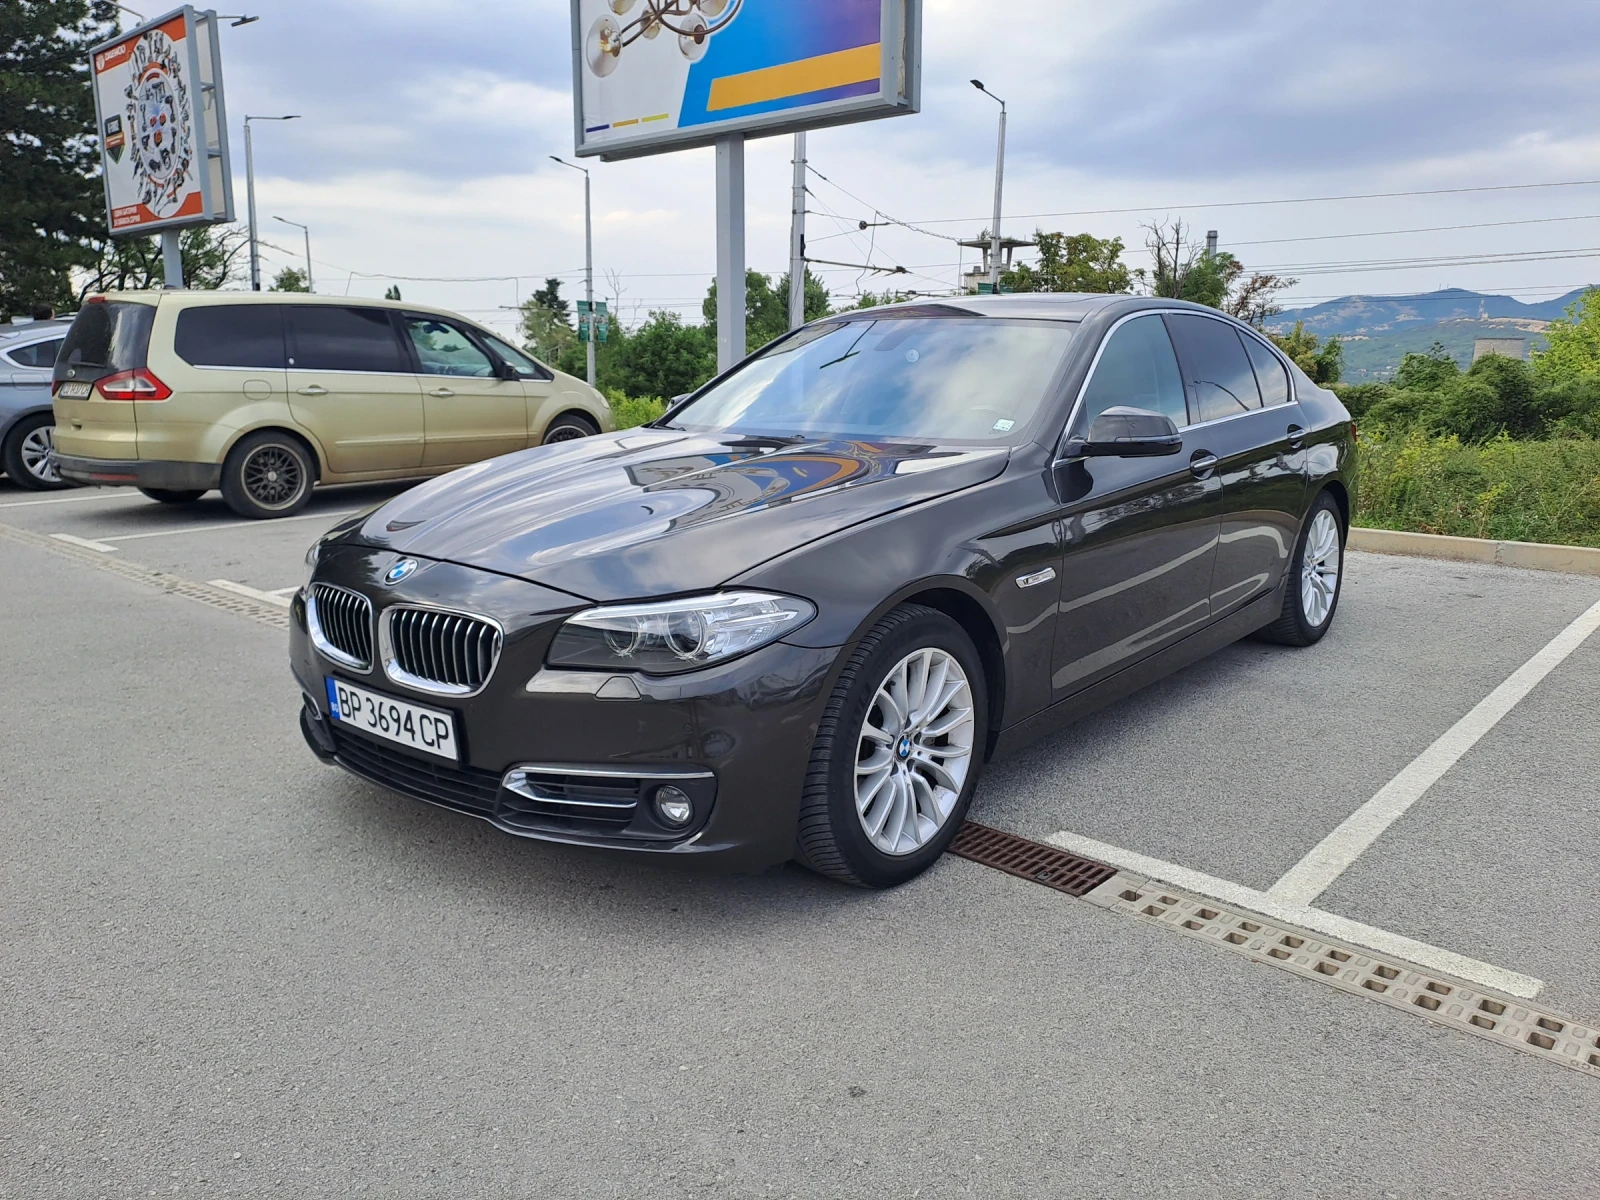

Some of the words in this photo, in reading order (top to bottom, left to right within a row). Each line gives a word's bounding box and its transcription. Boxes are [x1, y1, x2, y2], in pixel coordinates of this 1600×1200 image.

[338, 686, 361, 721] BP
[365, 697, 416, 742] 3694
[419, 714, 449, 750] CP
